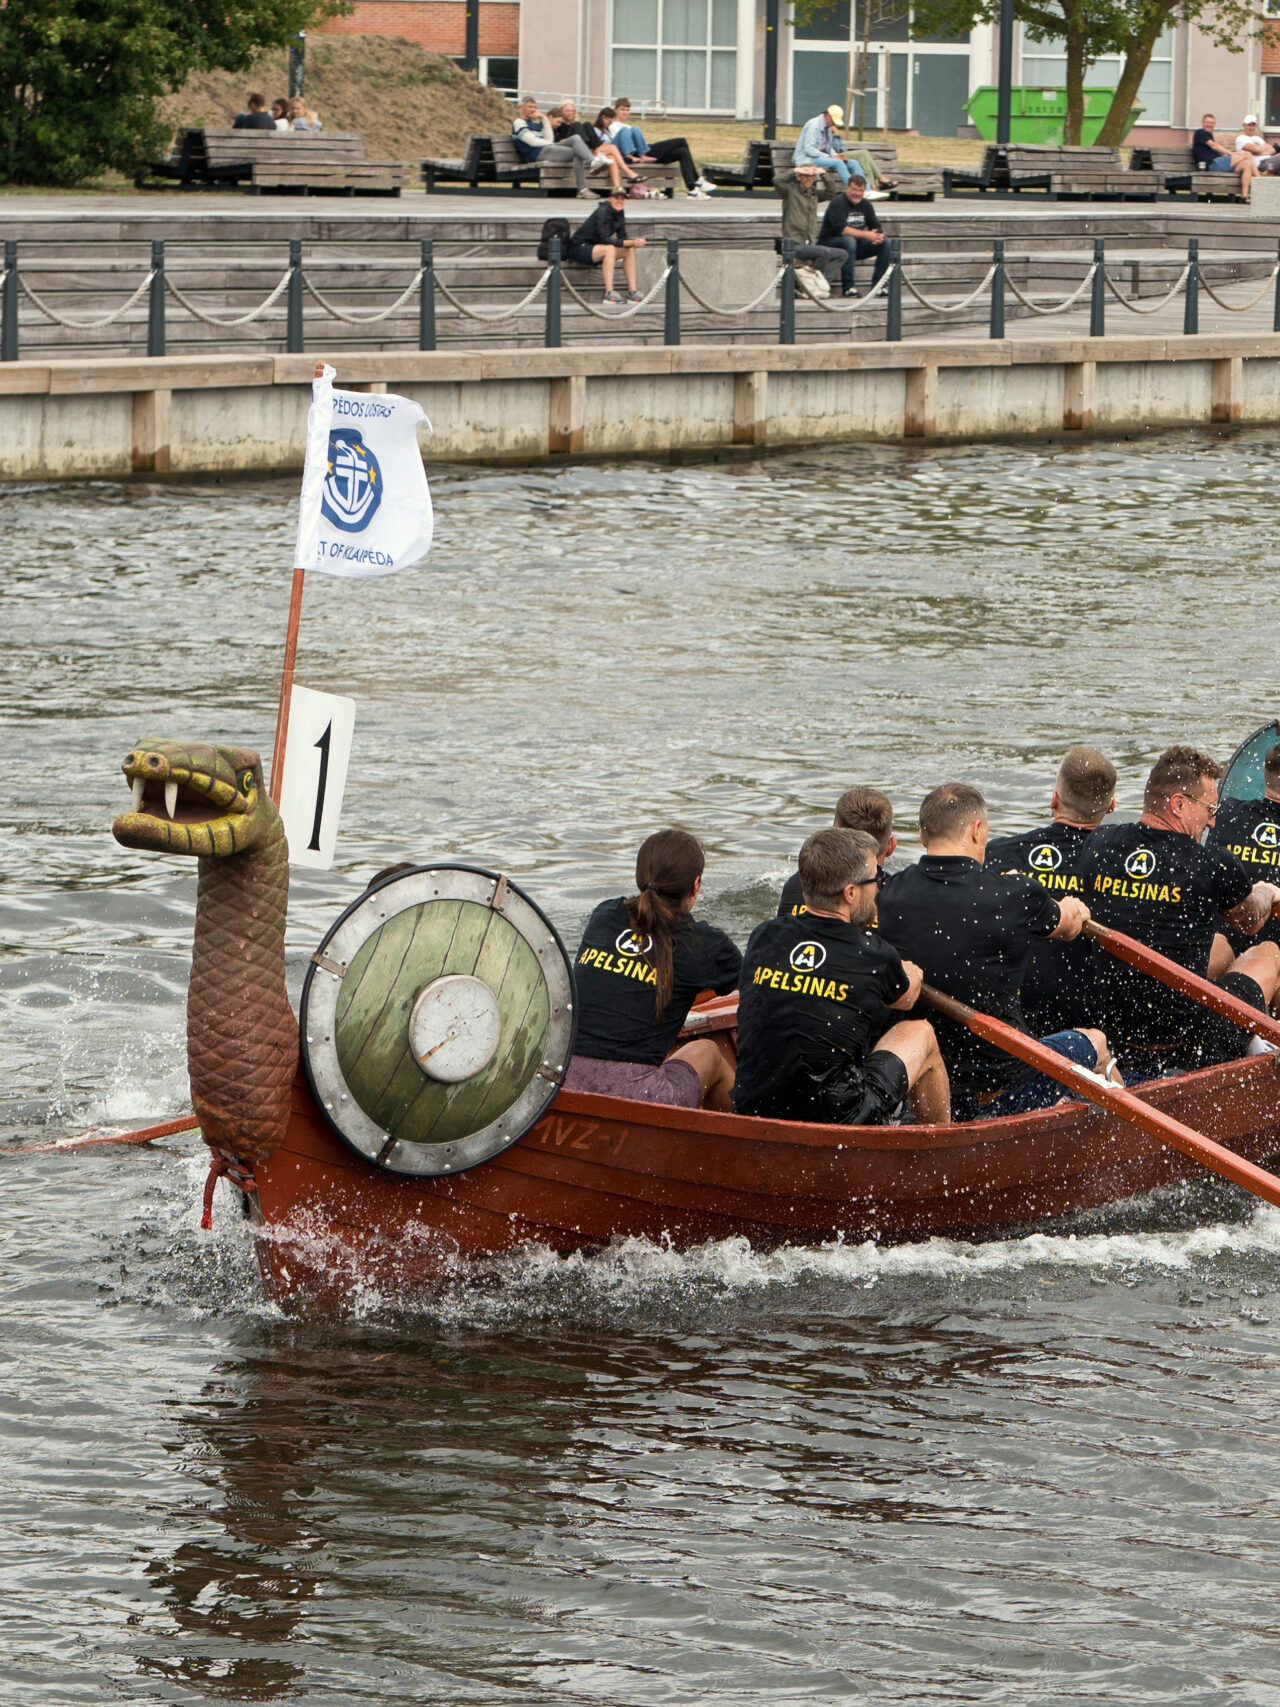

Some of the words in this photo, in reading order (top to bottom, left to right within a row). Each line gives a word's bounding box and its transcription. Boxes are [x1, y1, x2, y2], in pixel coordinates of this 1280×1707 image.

[329, 543, 345, 558] OF
[343, 546, 394, 567] KLAIPĖDA
[307, 717, 333, 852] 1
[1094, 874, 1182, 903] APELSINAS
[579, 947, 657, 986] APELSINA
[753, 966, 849, 1001] APELSINAS
